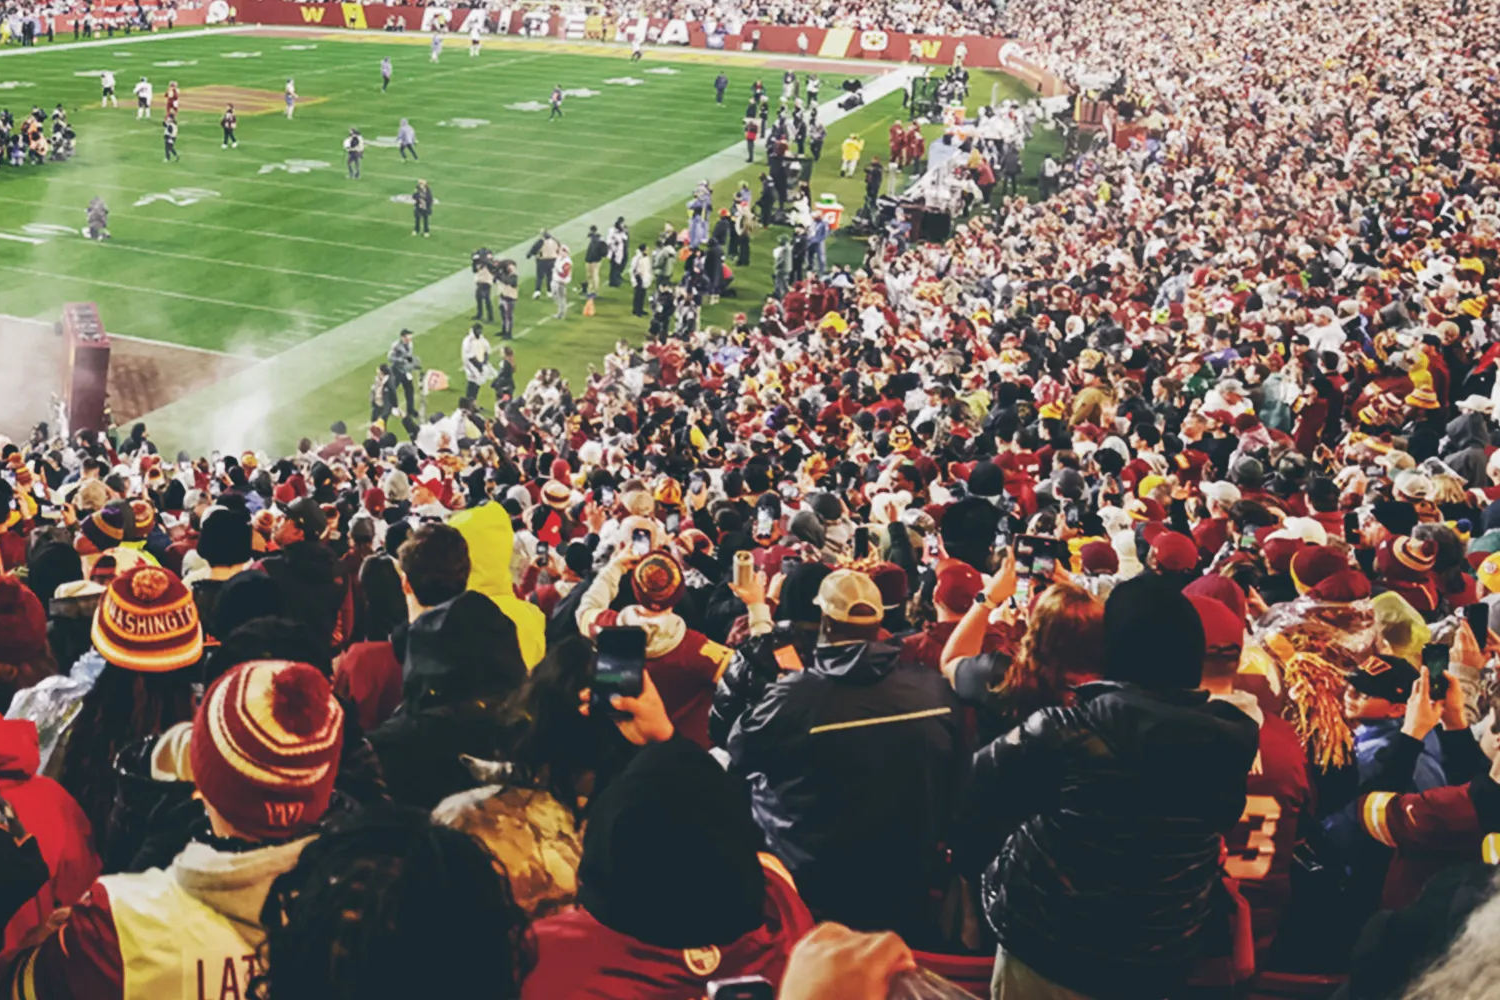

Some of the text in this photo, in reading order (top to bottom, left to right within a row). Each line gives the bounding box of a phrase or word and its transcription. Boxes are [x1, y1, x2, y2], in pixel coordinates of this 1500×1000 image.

[300, 6, 326, 23] W
[109, 602, 195, 635] WASHINGTO
[1223, 794, 1282, 880] 3
